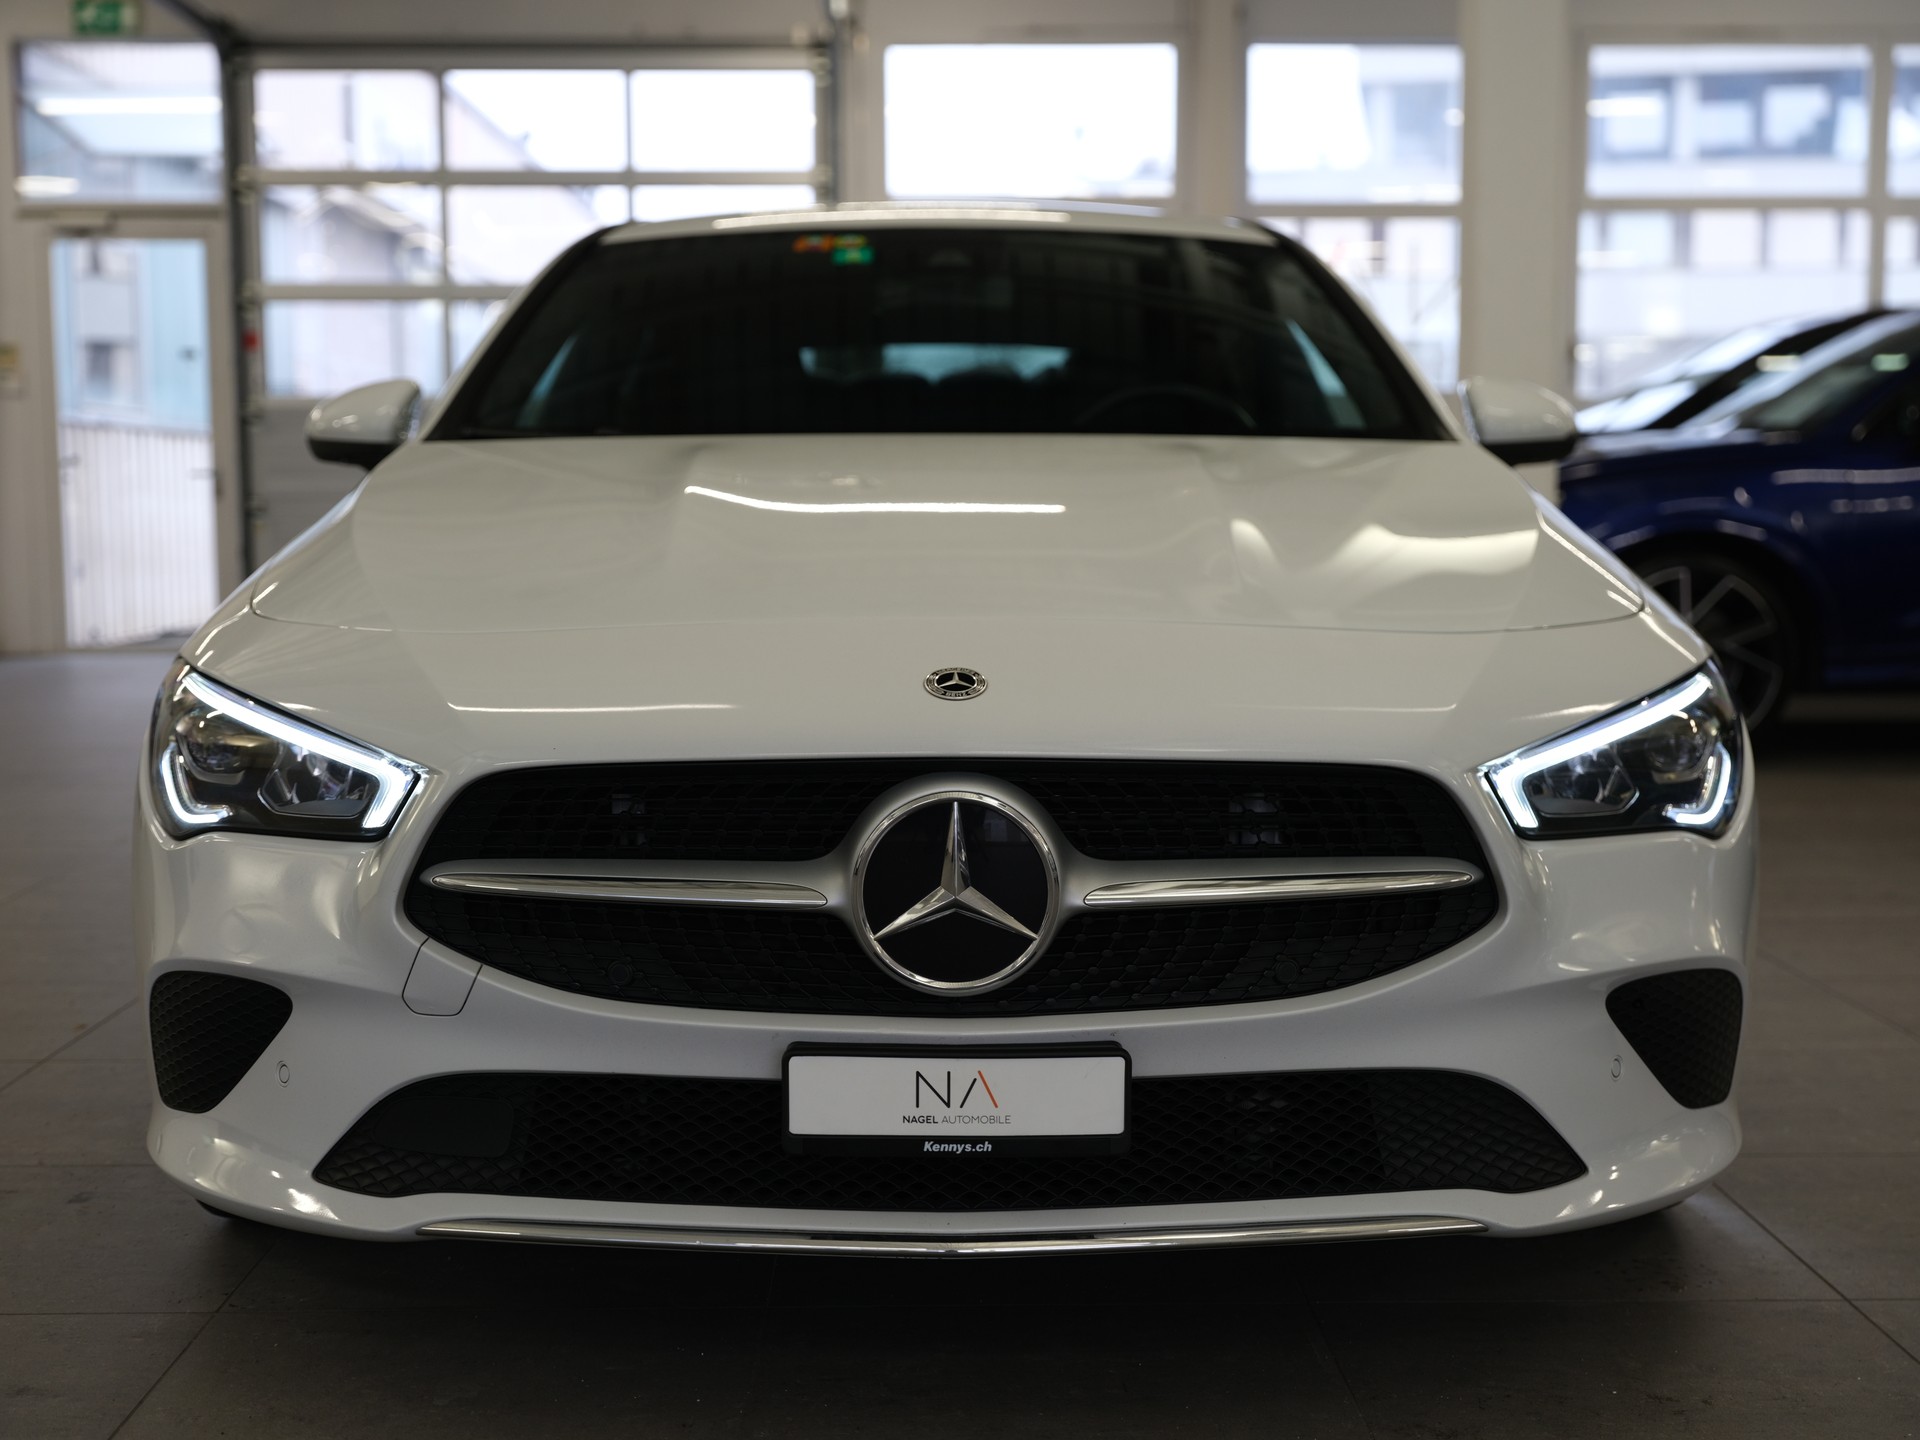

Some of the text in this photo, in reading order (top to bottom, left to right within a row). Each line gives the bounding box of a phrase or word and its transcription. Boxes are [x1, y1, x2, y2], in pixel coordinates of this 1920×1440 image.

[902, 1115, 1011, 1124] NAGEL AUTOMOBILE
[923, 1141, 992, 1154] Kennys.ch
